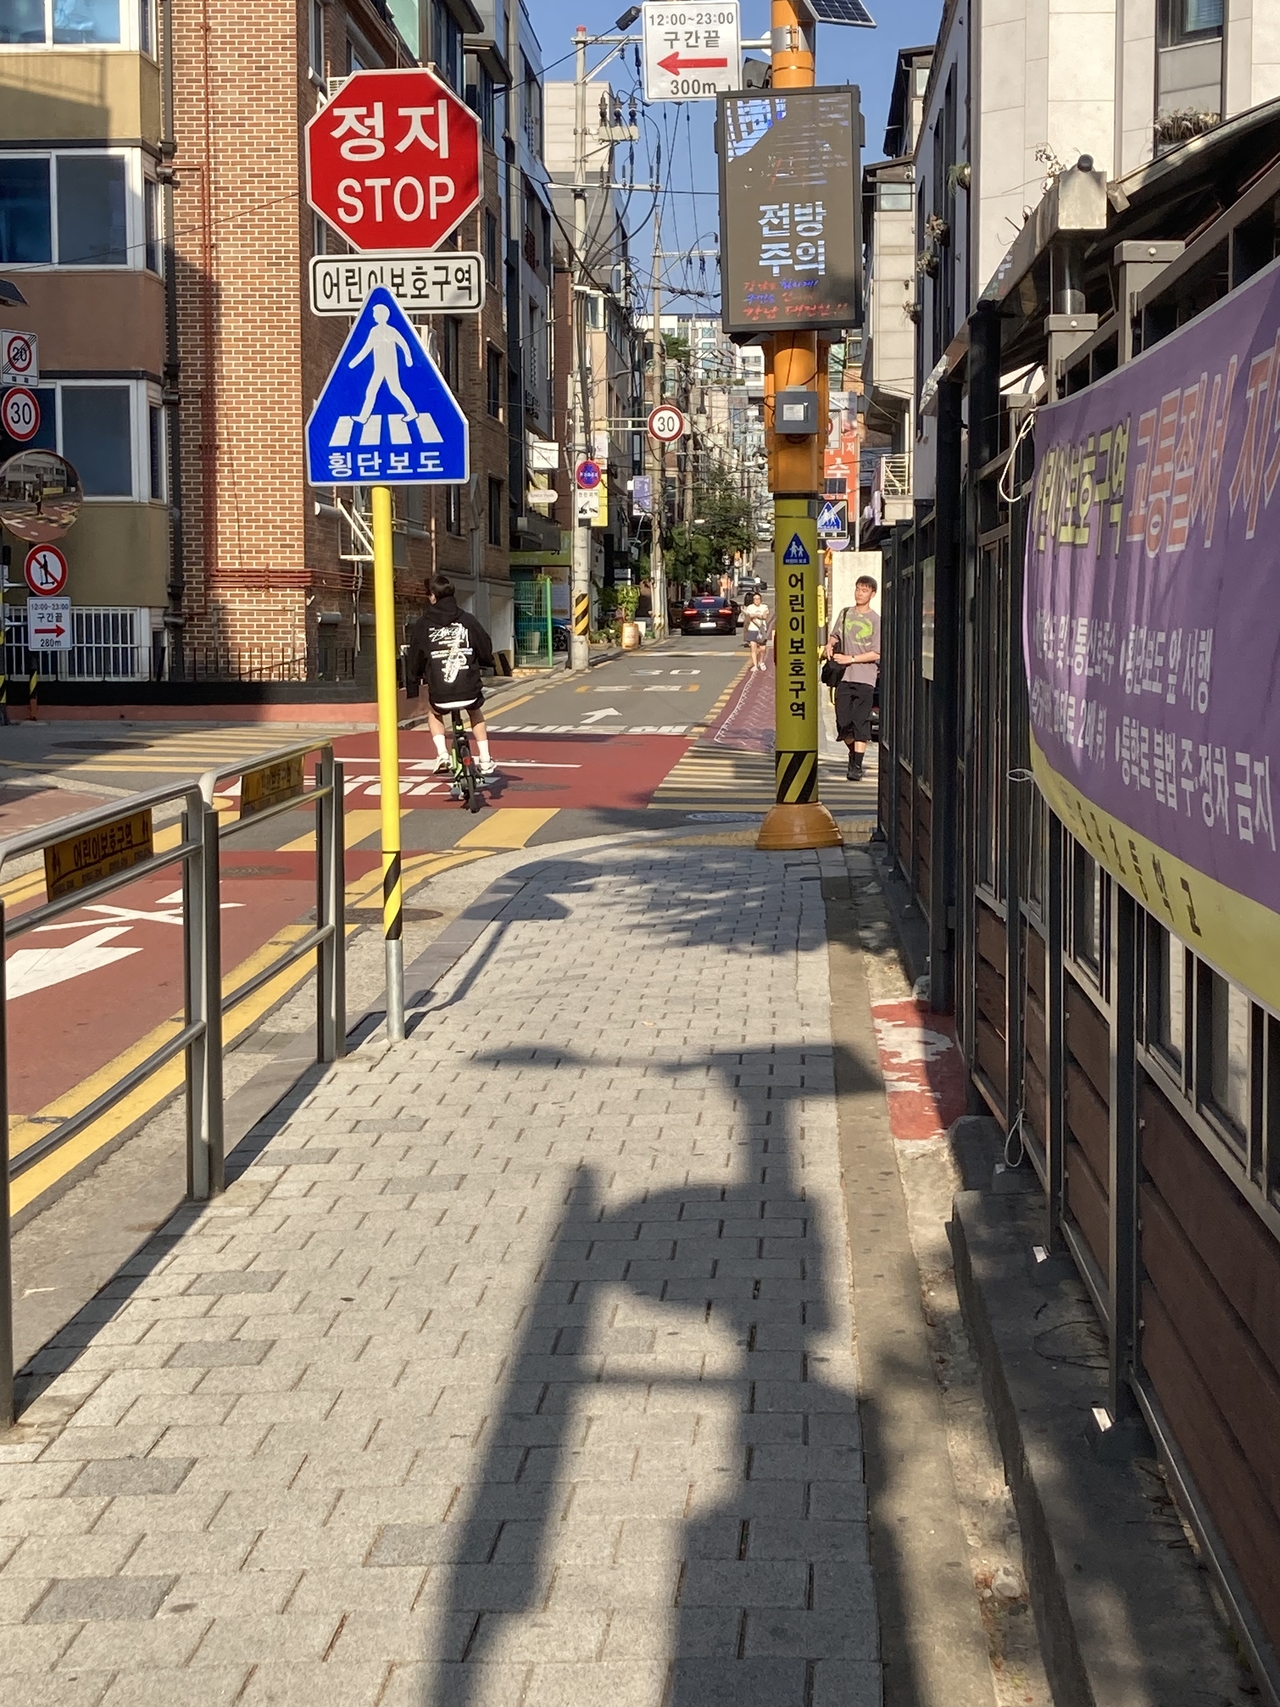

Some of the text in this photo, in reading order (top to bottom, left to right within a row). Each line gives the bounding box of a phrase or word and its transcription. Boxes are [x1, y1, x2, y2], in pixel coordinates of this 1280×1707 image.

[648, 12, 734, 26] 12:00~23:00
[663, 30, 720, 49] 구간끝
[670, 79, 717, 96] 300m
[329, 98, 450, 163] 정지
[336, 175, 456, 224] STOP
[757, 201, 828, 238] 전방
[758, 240, 826, 277] 주의
[12, 346, 28, 362] 20
[10, 401, 32, 426] 30
[657, 416, 675, 432] 30
[1125, 354, 1239, 559] 교통질서
[1229, 327, 1280, 540] 지
[327, 451, 445, 478] 횡단보도
[40, 638, 62, 648] 280m
[787, 571, 807, 721] 어린이보호구역
[1124, 623, 1166, 696] 횡단보도
[1166, 627, 1183, 706] 앞
[1181, 627, 1214, 715] 서행
[1120, 715, 1151, 792] 통학로
[1153, 728, 1178, 812] 불법
[1234, 750, 1277, 853] 금지
